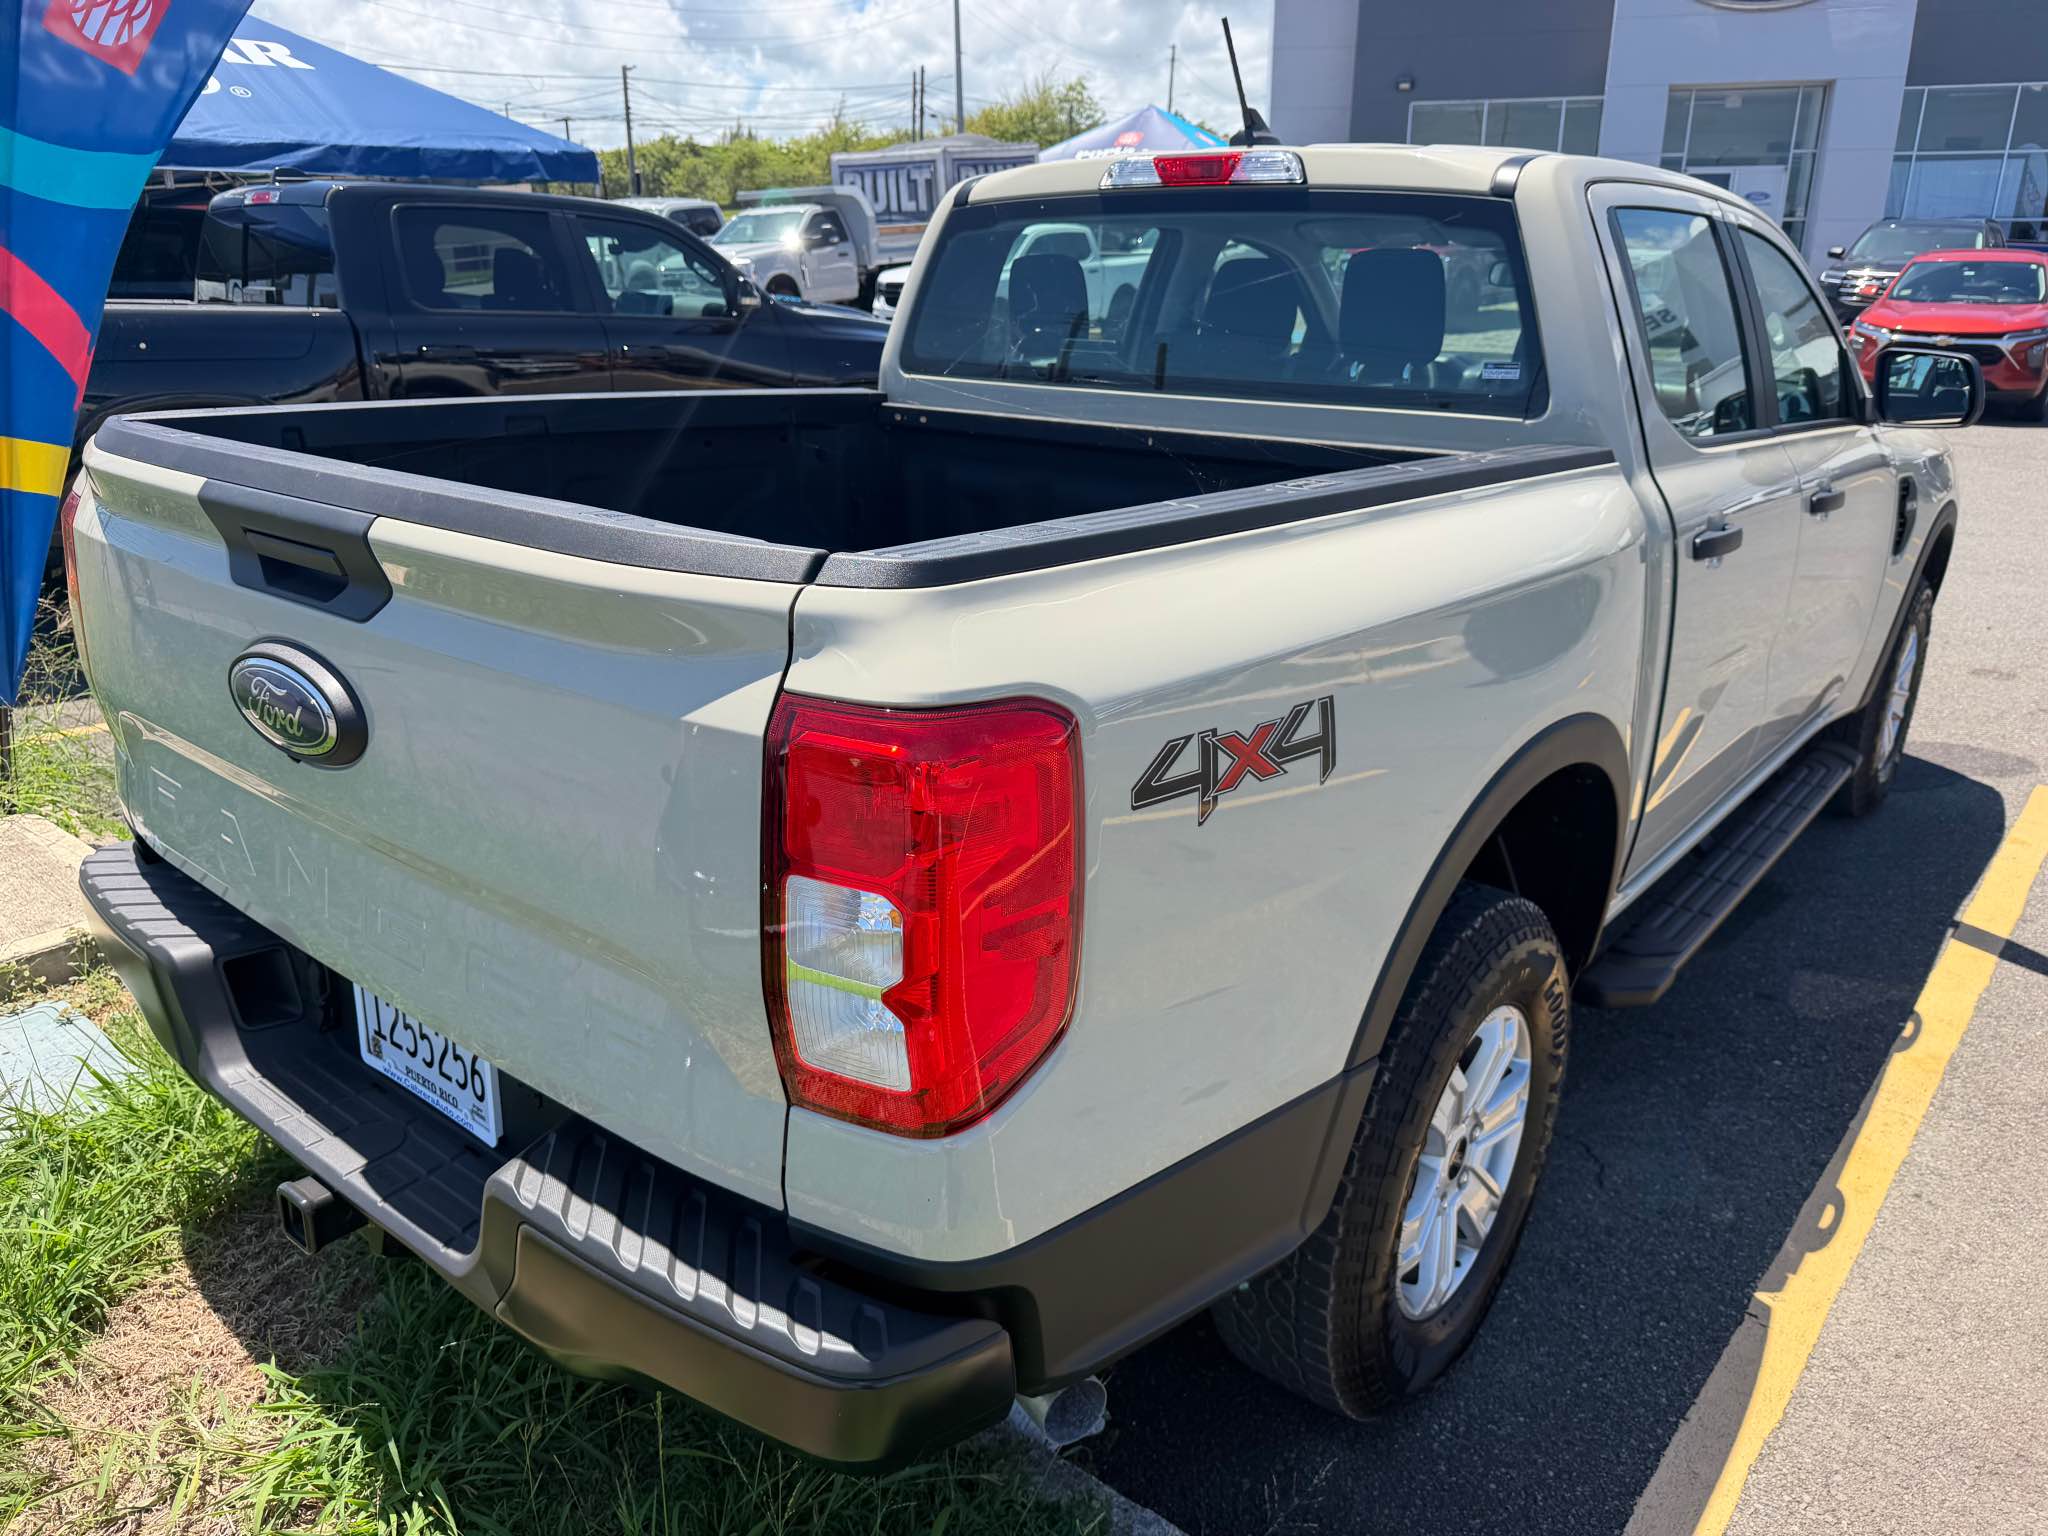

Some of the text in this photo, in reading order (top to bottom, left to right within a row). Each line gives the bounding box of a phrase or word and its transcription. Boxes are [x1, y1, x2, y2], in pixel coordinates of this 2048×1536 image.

[247, 675, 304, 737] Ford
[372, 994, 486, 1103] 1255256
[405, 1065, 459, 1108] PUERTO RICO
